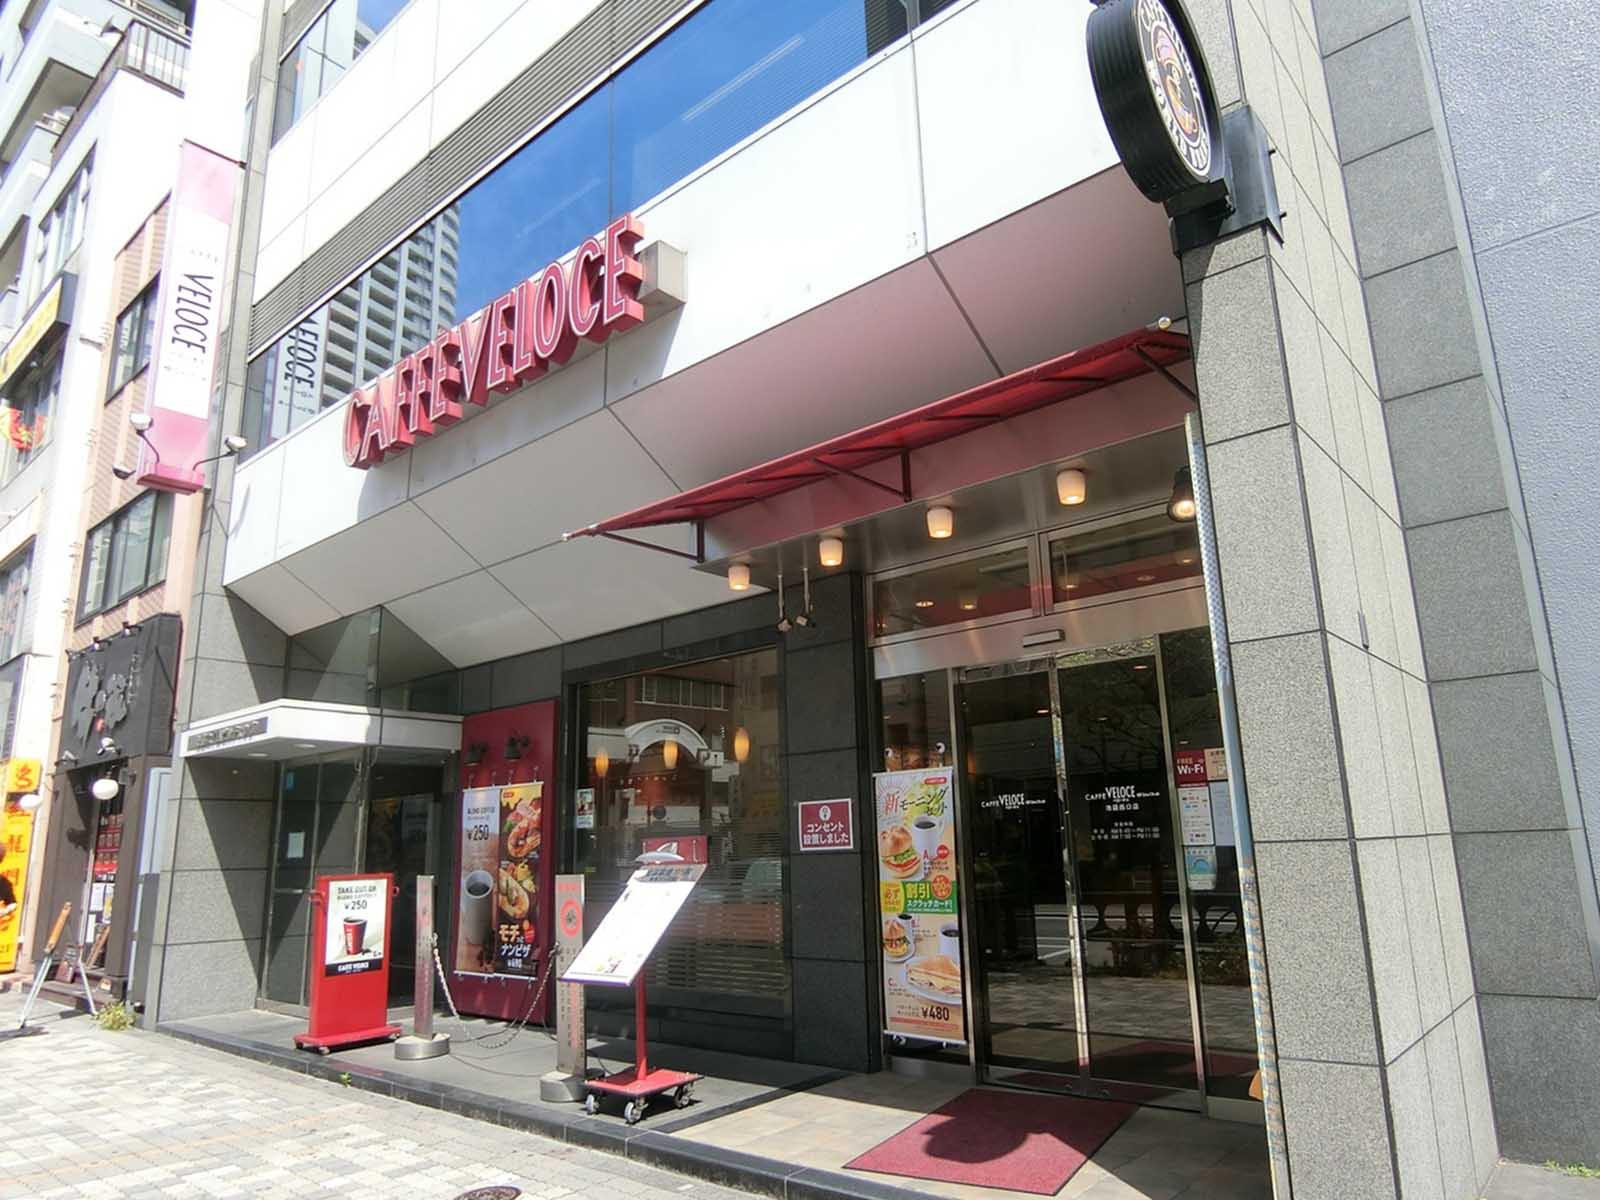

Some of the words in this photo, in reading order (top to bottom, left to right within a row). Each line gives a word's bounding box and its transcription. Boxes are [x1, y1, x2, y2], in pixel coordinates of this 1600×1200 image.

[171, 273, 214, 354] VELOCE
[457, 211, 643, 407] VELOCE
[999, 793, 1025, 806] VELOCE
[1105, 785, 1135, 800] VELOCE
[807, 821, 845, 833] コンセント
[344, 899, 368, 910] ¥250
[921, 1005, 950, 1022] ¥480
